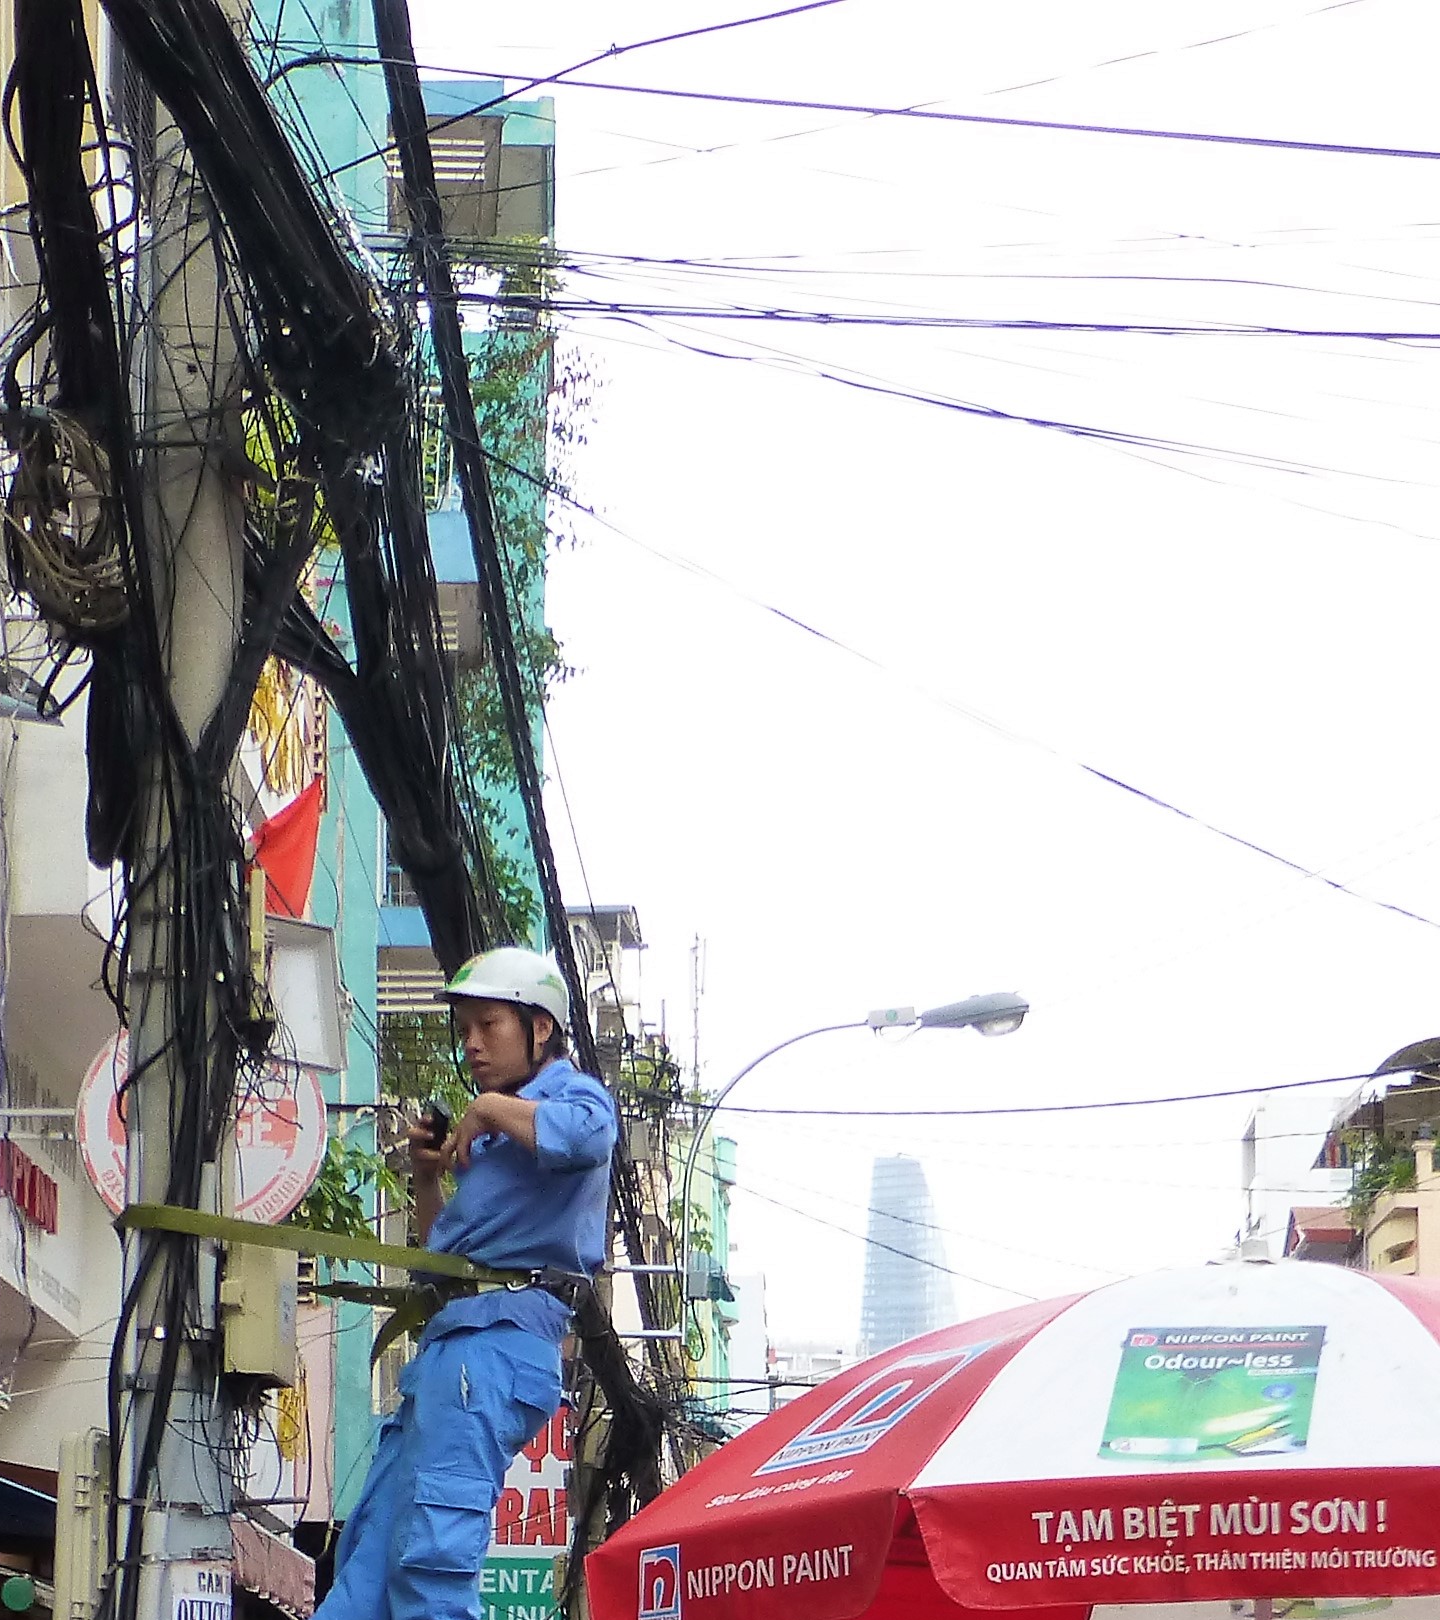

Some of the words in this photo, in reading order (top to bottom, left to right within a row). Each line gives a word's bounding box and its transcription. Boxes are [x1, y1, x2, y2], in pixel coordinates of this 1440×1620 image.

[1165, 1333, 1244, 1345] NIPPON
[1249, 1331, 1310, 1343] PAINT
[1032, 1507, 1113, 1553] TẠM
[1123, 1498, 1200, 1548] BIỆT
[1210, 1496, 1281, 1537] MÙI
[1290, 1495, 1367, 1535] SƠN
[687, 1557, 775, 1600] NIPPON
[782, 1545, 854, 1586] PAINT
[986, 1560, 1043, 1584] QUAN
[1045, 1553, 1087, 1579] TÂM
[1090, 1553, 1129, 1577] SỨC
[1193, 1549, 1247, 1571] THÂN
[1251, 1548, 1307, 1575] THIỆN
[1310, 1548, 1350, 1570] MÔI
[1351, 1544, 1437, 1569] TRƯỜNG
